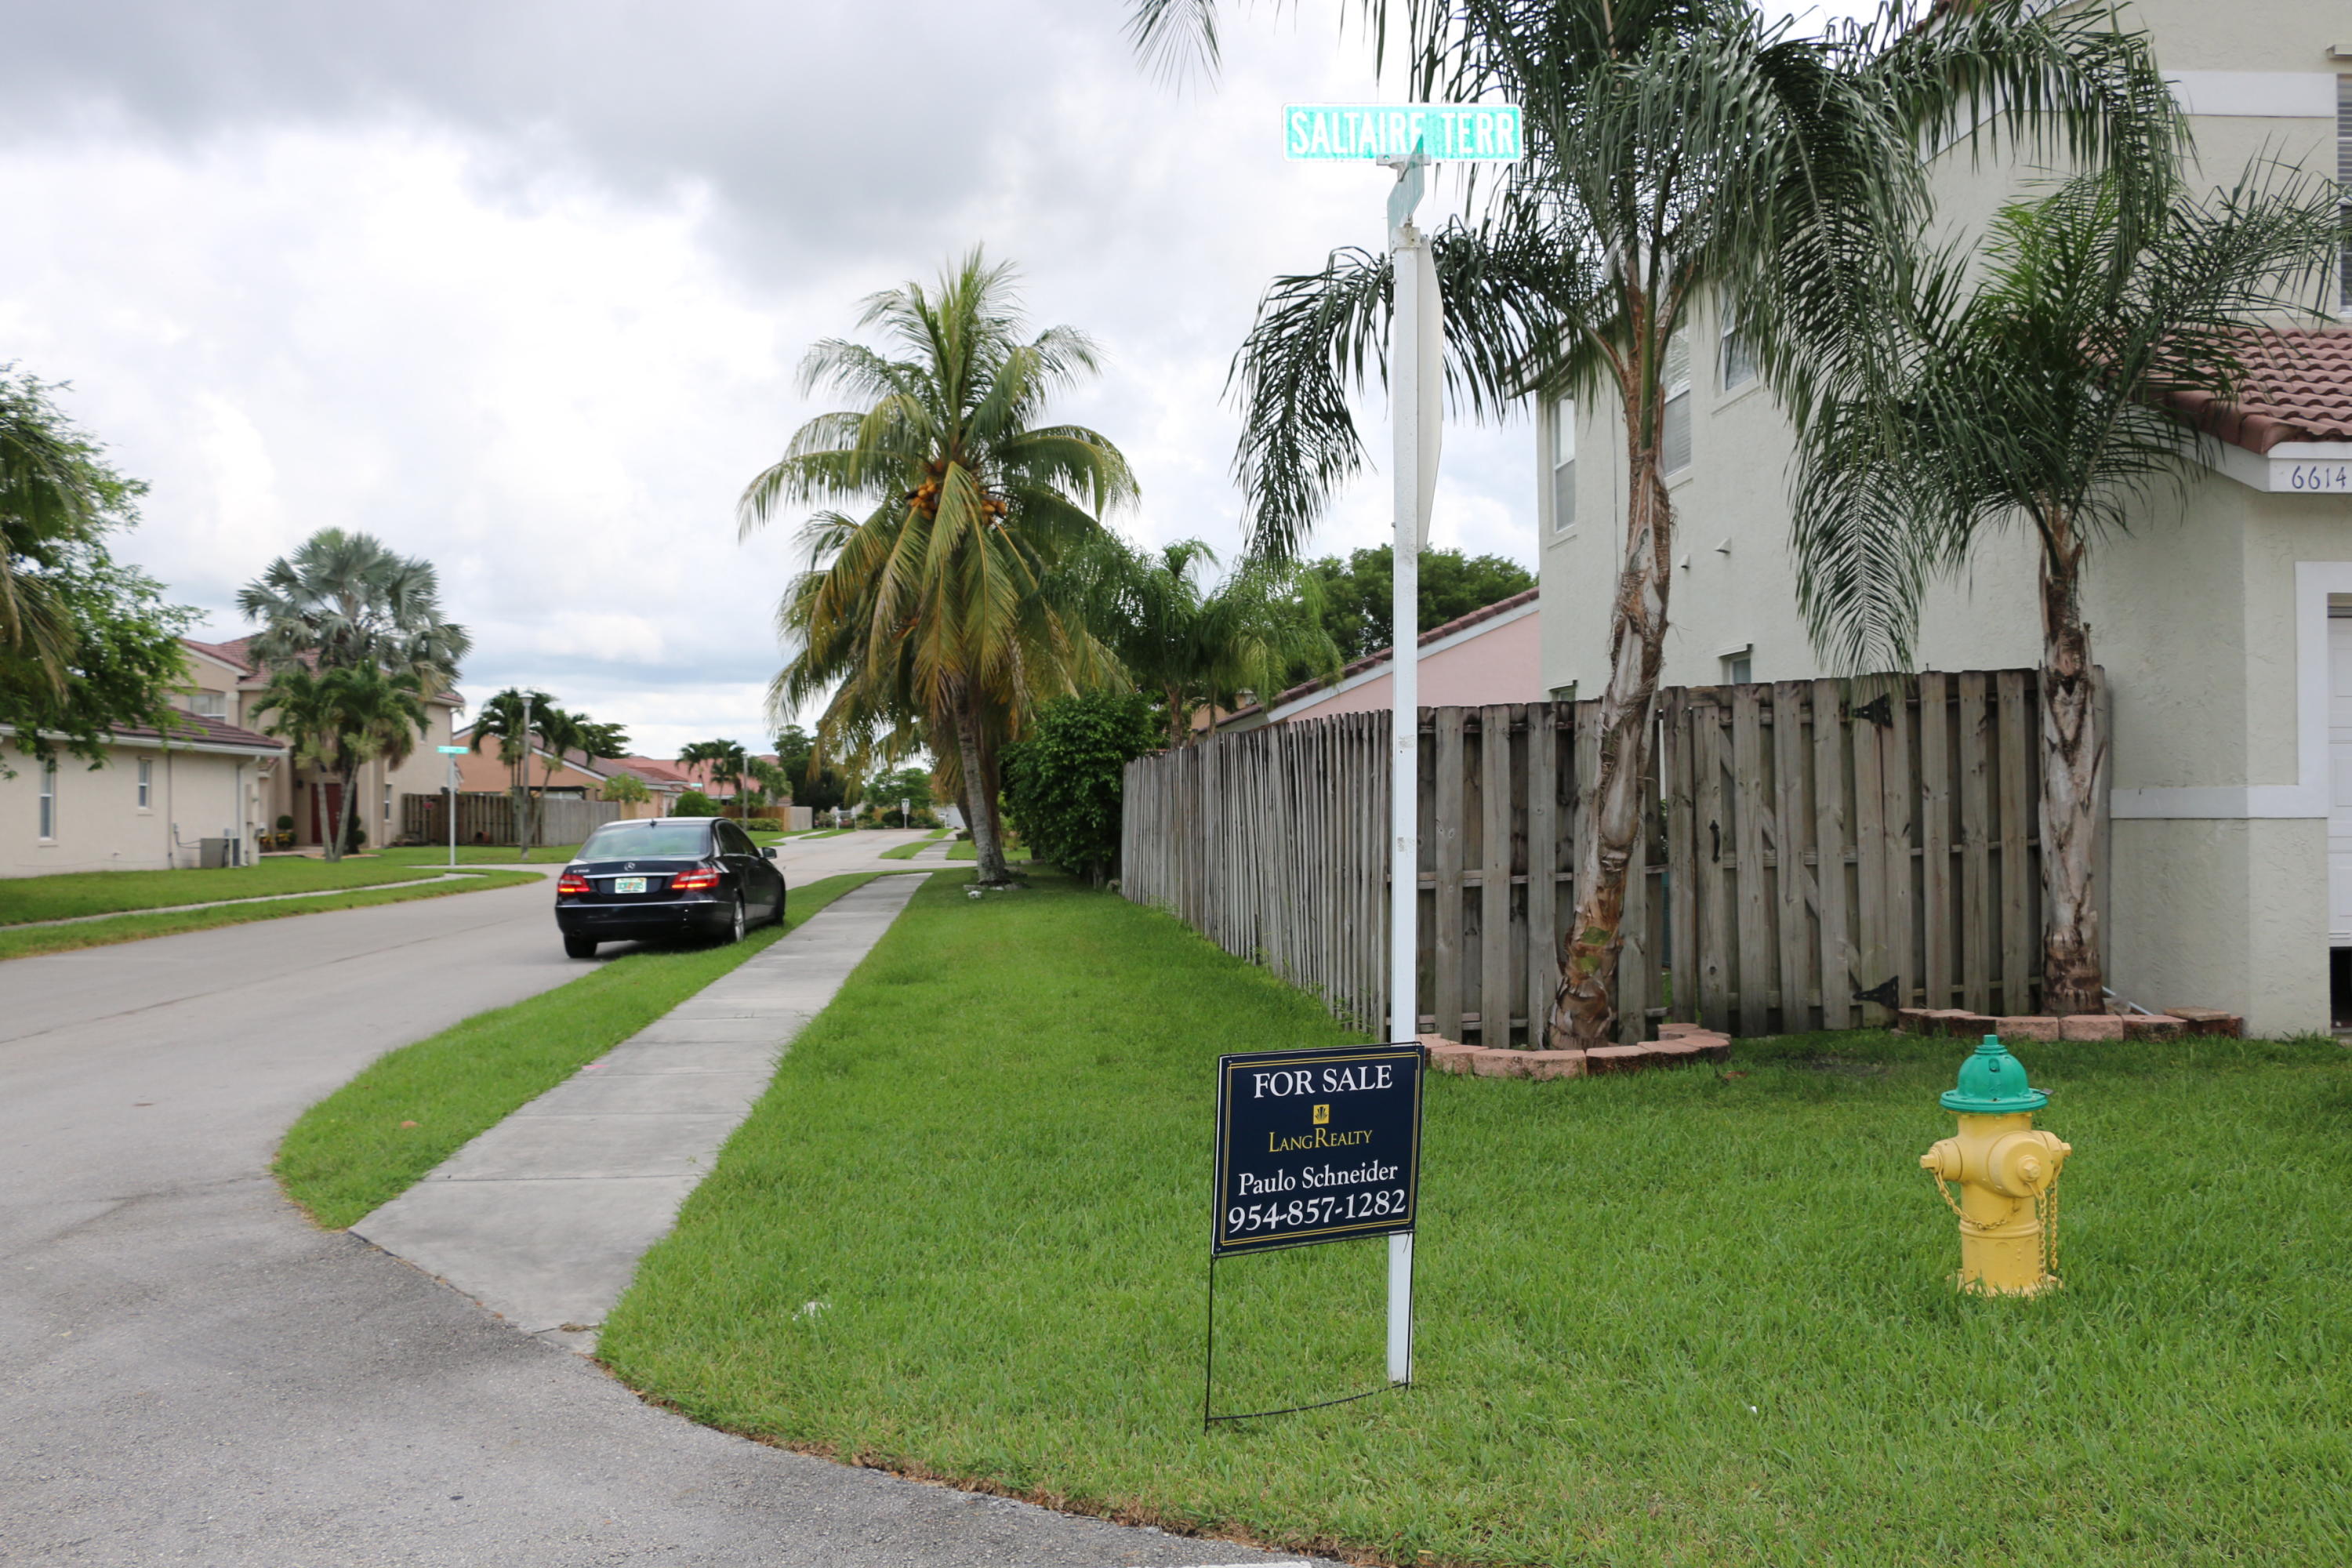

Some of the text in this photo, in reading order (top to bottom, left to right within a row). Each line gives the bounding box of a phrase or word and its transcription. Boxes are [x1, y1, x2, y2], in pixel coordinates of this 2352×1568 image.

[1441, 112, 1514, 154] TERR
[2292, 465, 2347, 490] 6614
[1253, 1065, 1393, 1098] FOR SALE
[1238, 1160, 1398, 1196] Paulo Schneider
[1229, 1189, 1406, 1234] 954-857-1282
